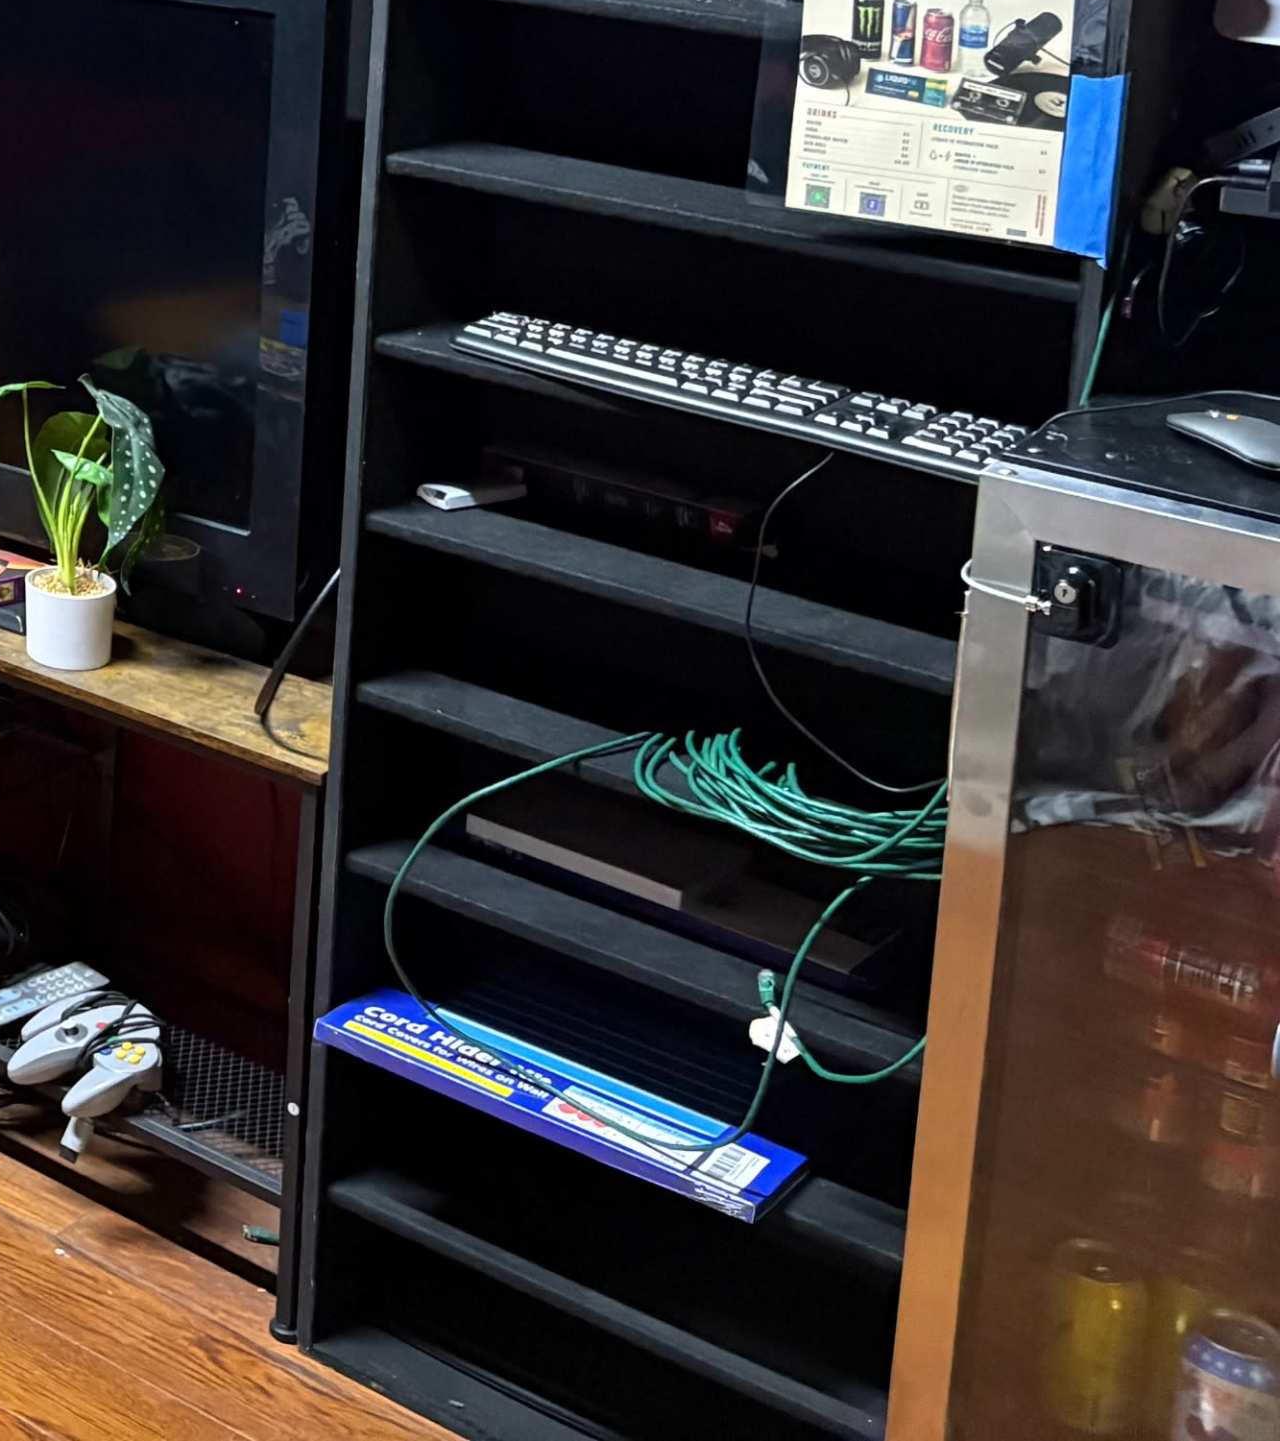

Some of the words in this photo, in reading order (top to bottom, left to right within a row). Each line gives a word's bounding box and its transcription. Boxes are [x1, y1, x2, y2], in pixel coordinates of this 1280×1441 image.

[363, 1006, 429, 1035] Cord
[354, 1014, 389, 1031] Cord
[387, 1026, 433, 1050] Covers
[432, 1044, 456, 1059] for
[456, 1056, 496, 1075] Wires
[495, 1070, 516, 1085] on
[516, 1079, 550, 1100] Wall
